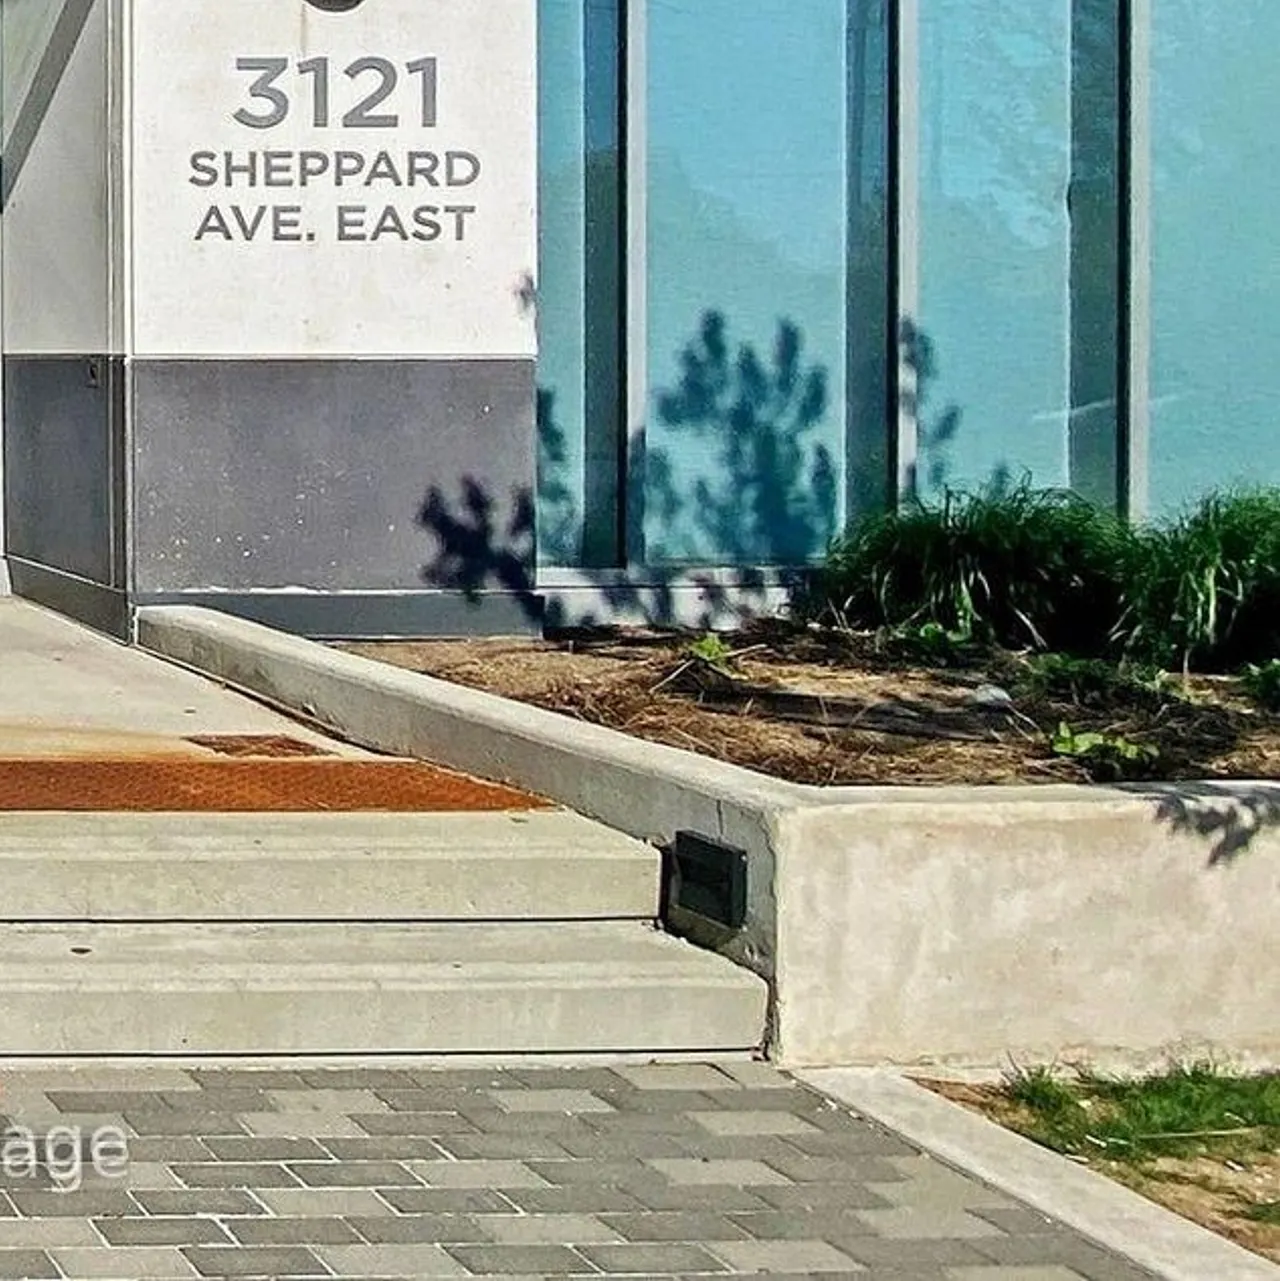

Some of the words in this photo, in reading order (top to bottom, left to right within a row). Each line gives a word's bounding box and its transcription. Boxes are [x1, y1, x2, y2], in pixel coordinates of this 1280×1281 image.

[233, 56, 437, 129] 3121
[189, 150, 481, 187] SHEPPARD
[195, 205, 315, 241] AVE.
[337, 205, 476, 241] EAST
